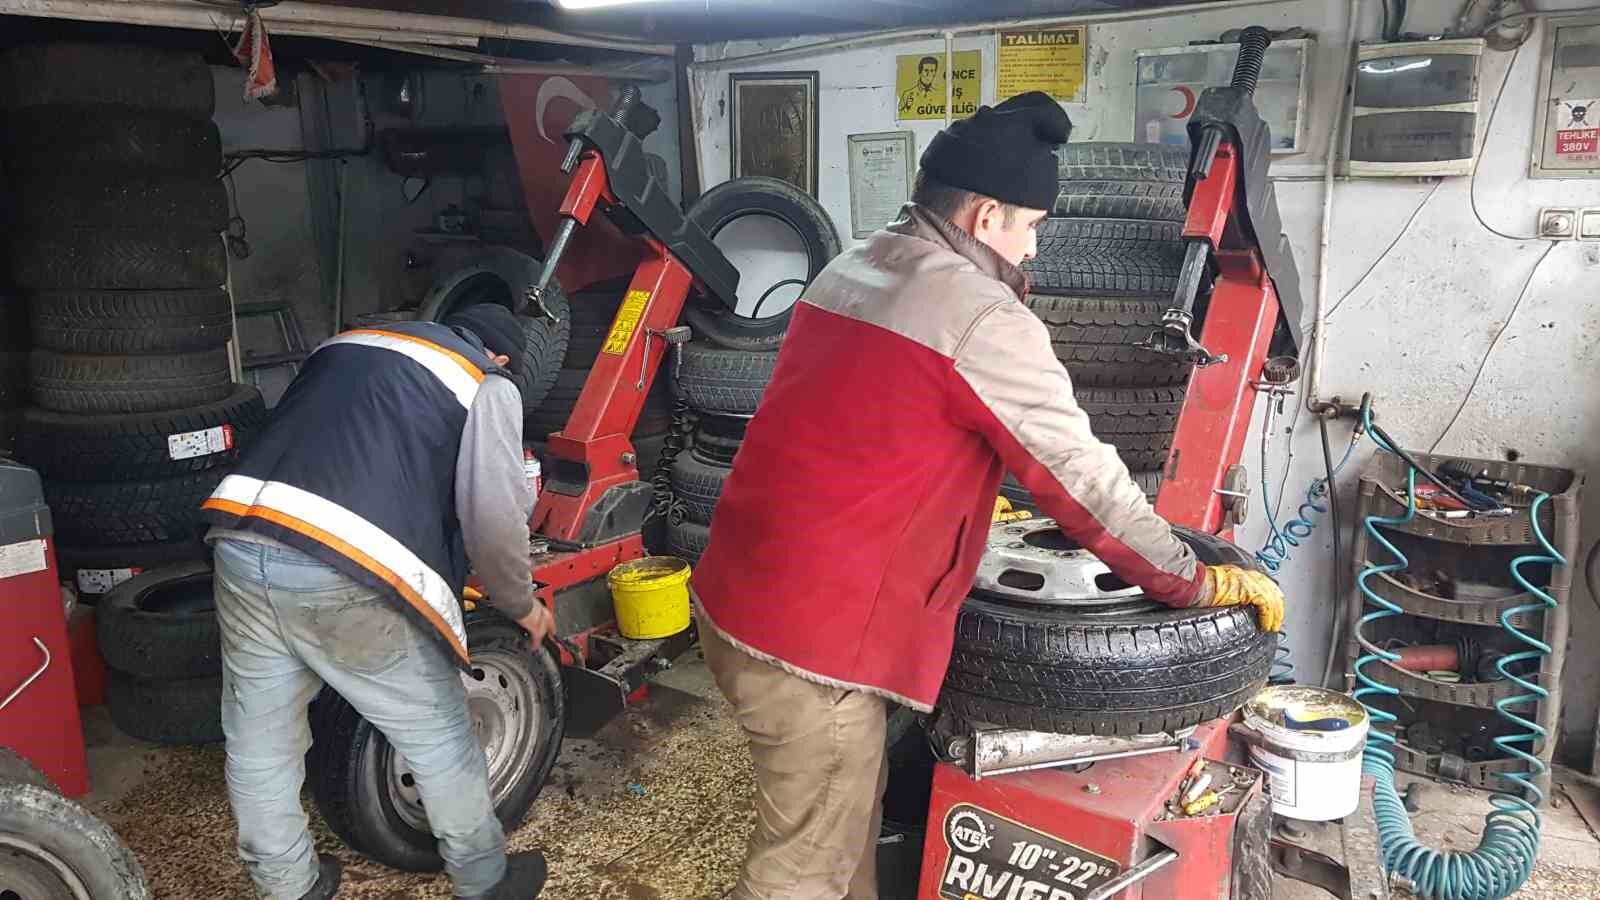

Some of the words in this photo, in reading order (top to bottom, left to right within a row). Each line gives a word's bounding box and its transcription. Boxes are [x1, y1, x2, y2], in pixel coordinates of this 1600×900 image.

[1006, 32, 1074, 45] TALİMAT
[1562, 142, 1590, 152] 380V
[953, 826, 994, 848] ATEK
